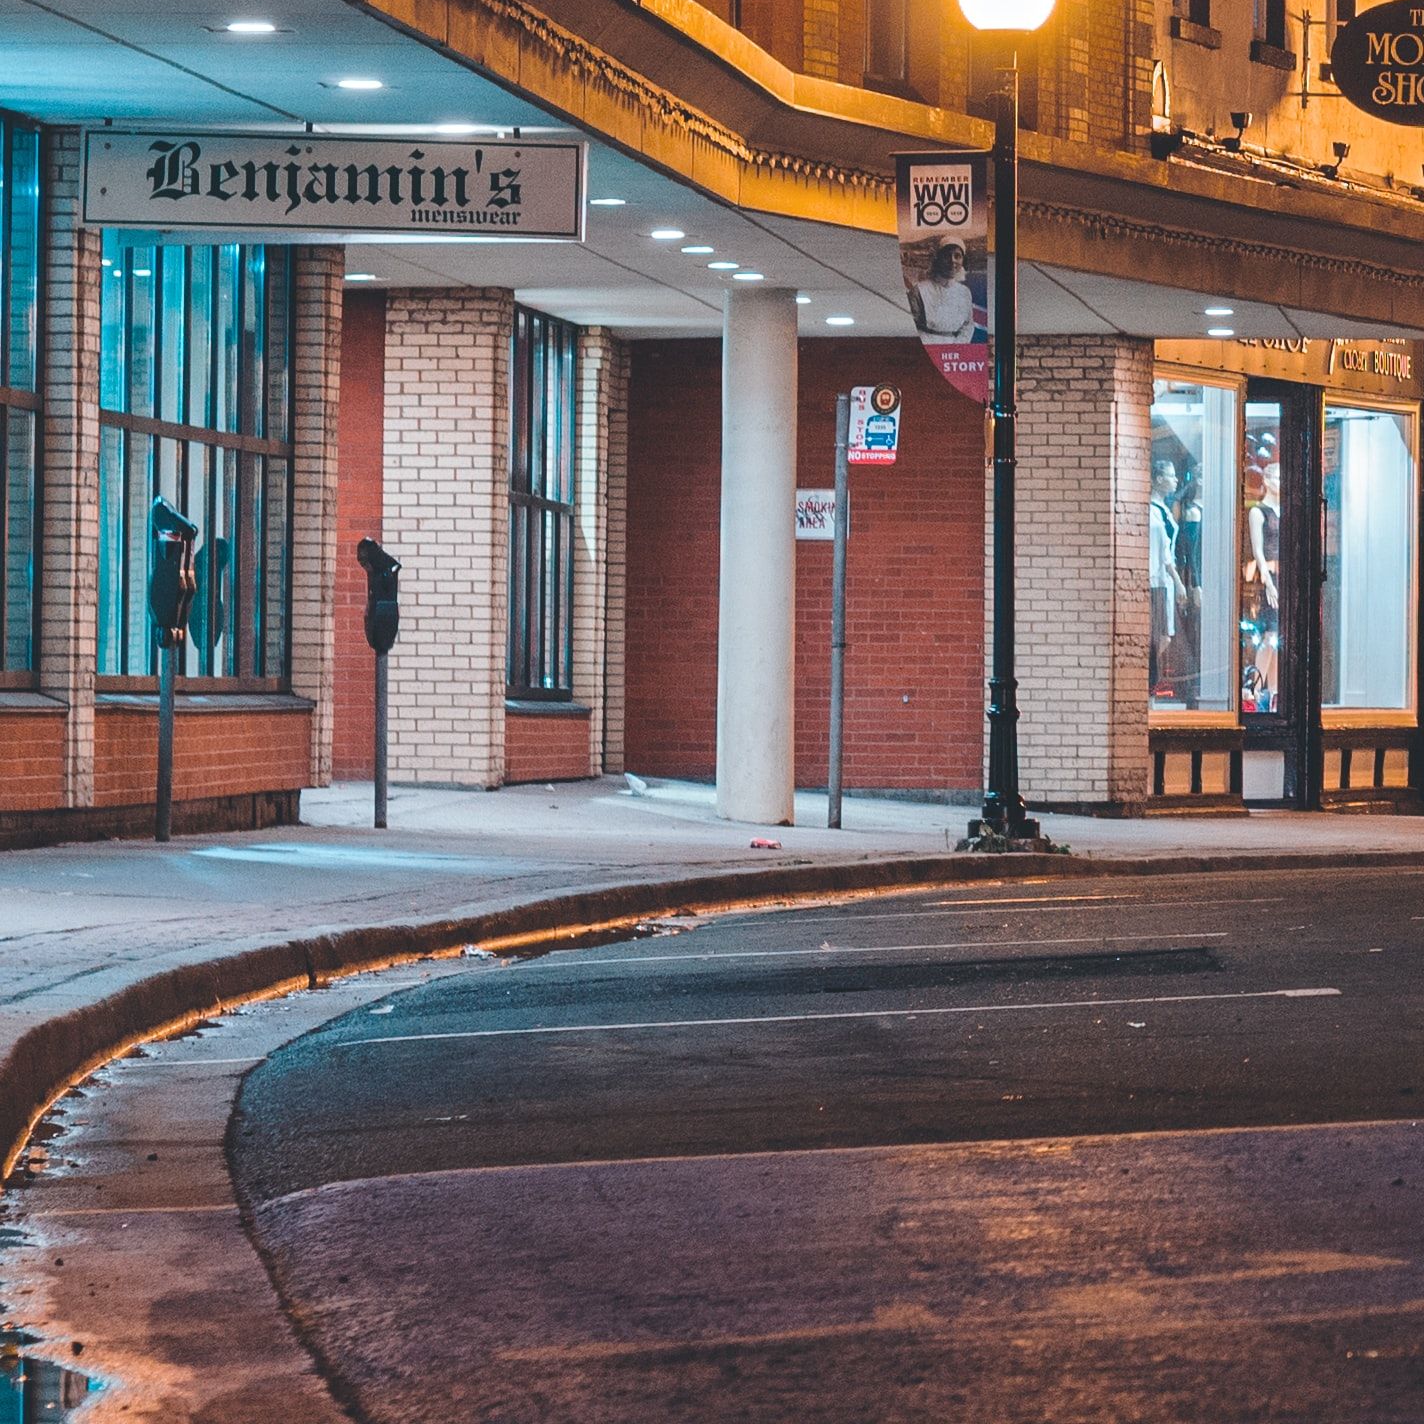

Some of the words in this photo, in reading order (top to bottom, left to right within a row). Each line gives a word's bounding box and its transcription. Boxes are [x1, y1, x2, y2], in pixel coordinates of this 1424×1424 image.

[146, 139, 522, 217] Benjamin's
[913, 176, 969, 184] REMEMBER
[410, 204, 521, 226] menswear
[914, 200, 969, 227] 100
[941, 352, 960, 361] HER
[943, 361, 985, 373] STORY
[1373, 350, 1411, 382] BOUTIQUE
[848, 451, 861, 461] NO
[861, 451, 896, 461] STOPPING
